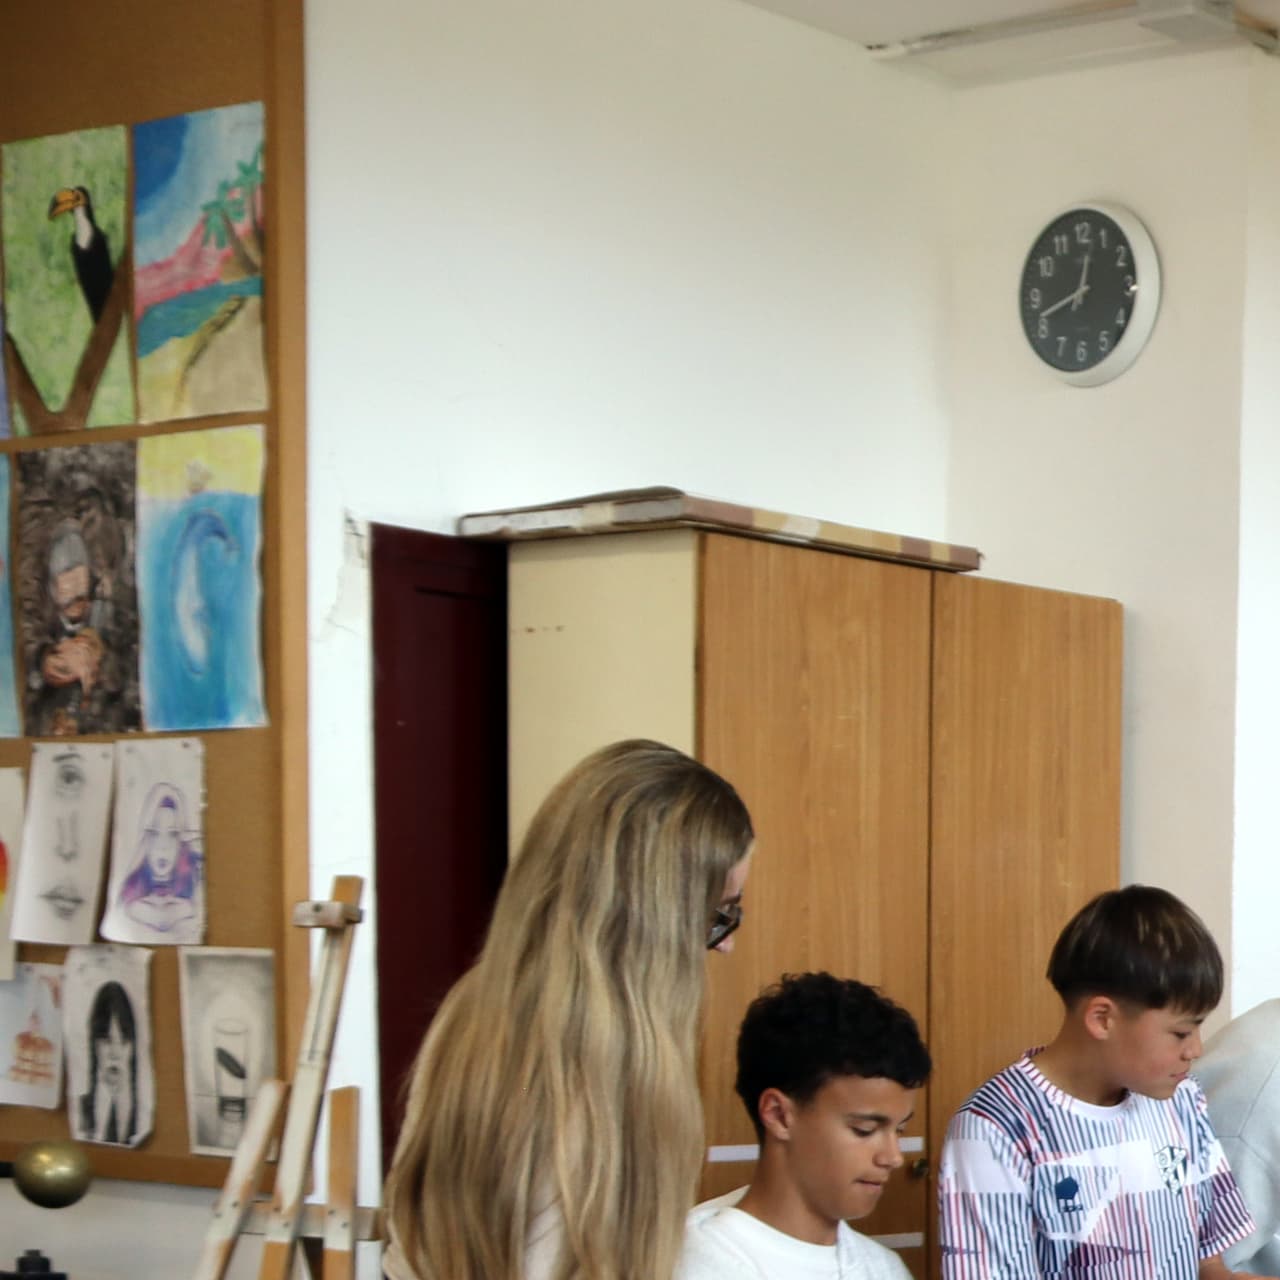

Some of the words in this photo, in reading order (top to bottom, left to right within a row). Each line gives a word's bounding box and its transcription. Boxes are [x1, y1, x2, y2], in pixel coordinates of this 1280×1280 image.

[1075, 222, 1091, 242] 12
[1100, 229, 1107, 248] 1
[1053, 235, 1069, 254] 11
[1116, 246, 1127, 266] 2
[1038, 256, 1054, 277] 10
[1029, 288, 1041, 309] 9
[1116, 308, 1125, 325] 4
[1038, 318, 1049, 338] 8
[1056, 337, 1067, 357] 7
[1099, 331, 1109, 351] 5
[1076, 342, 1087, 362] 6
